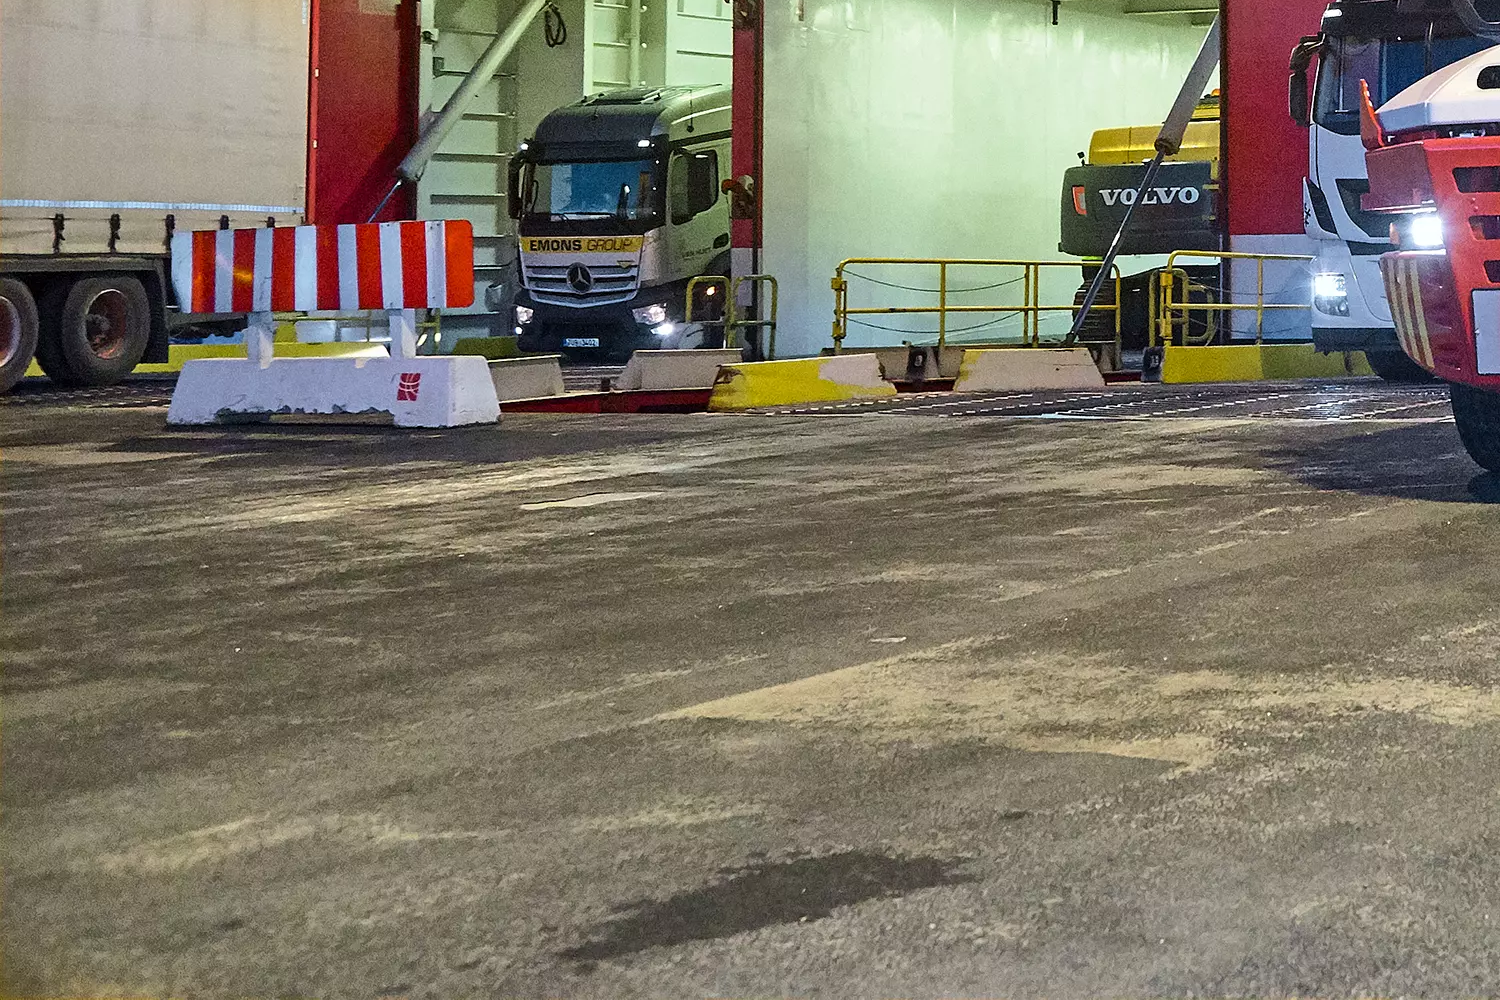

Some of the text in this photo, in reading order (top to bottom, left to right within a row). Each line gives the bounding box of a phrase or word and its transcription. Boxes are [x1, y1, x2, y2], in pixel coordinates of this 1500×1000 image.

[1099, 186, 1200, 206] VOLVO
[530, 238, 633, 252] EMONS GROUP
